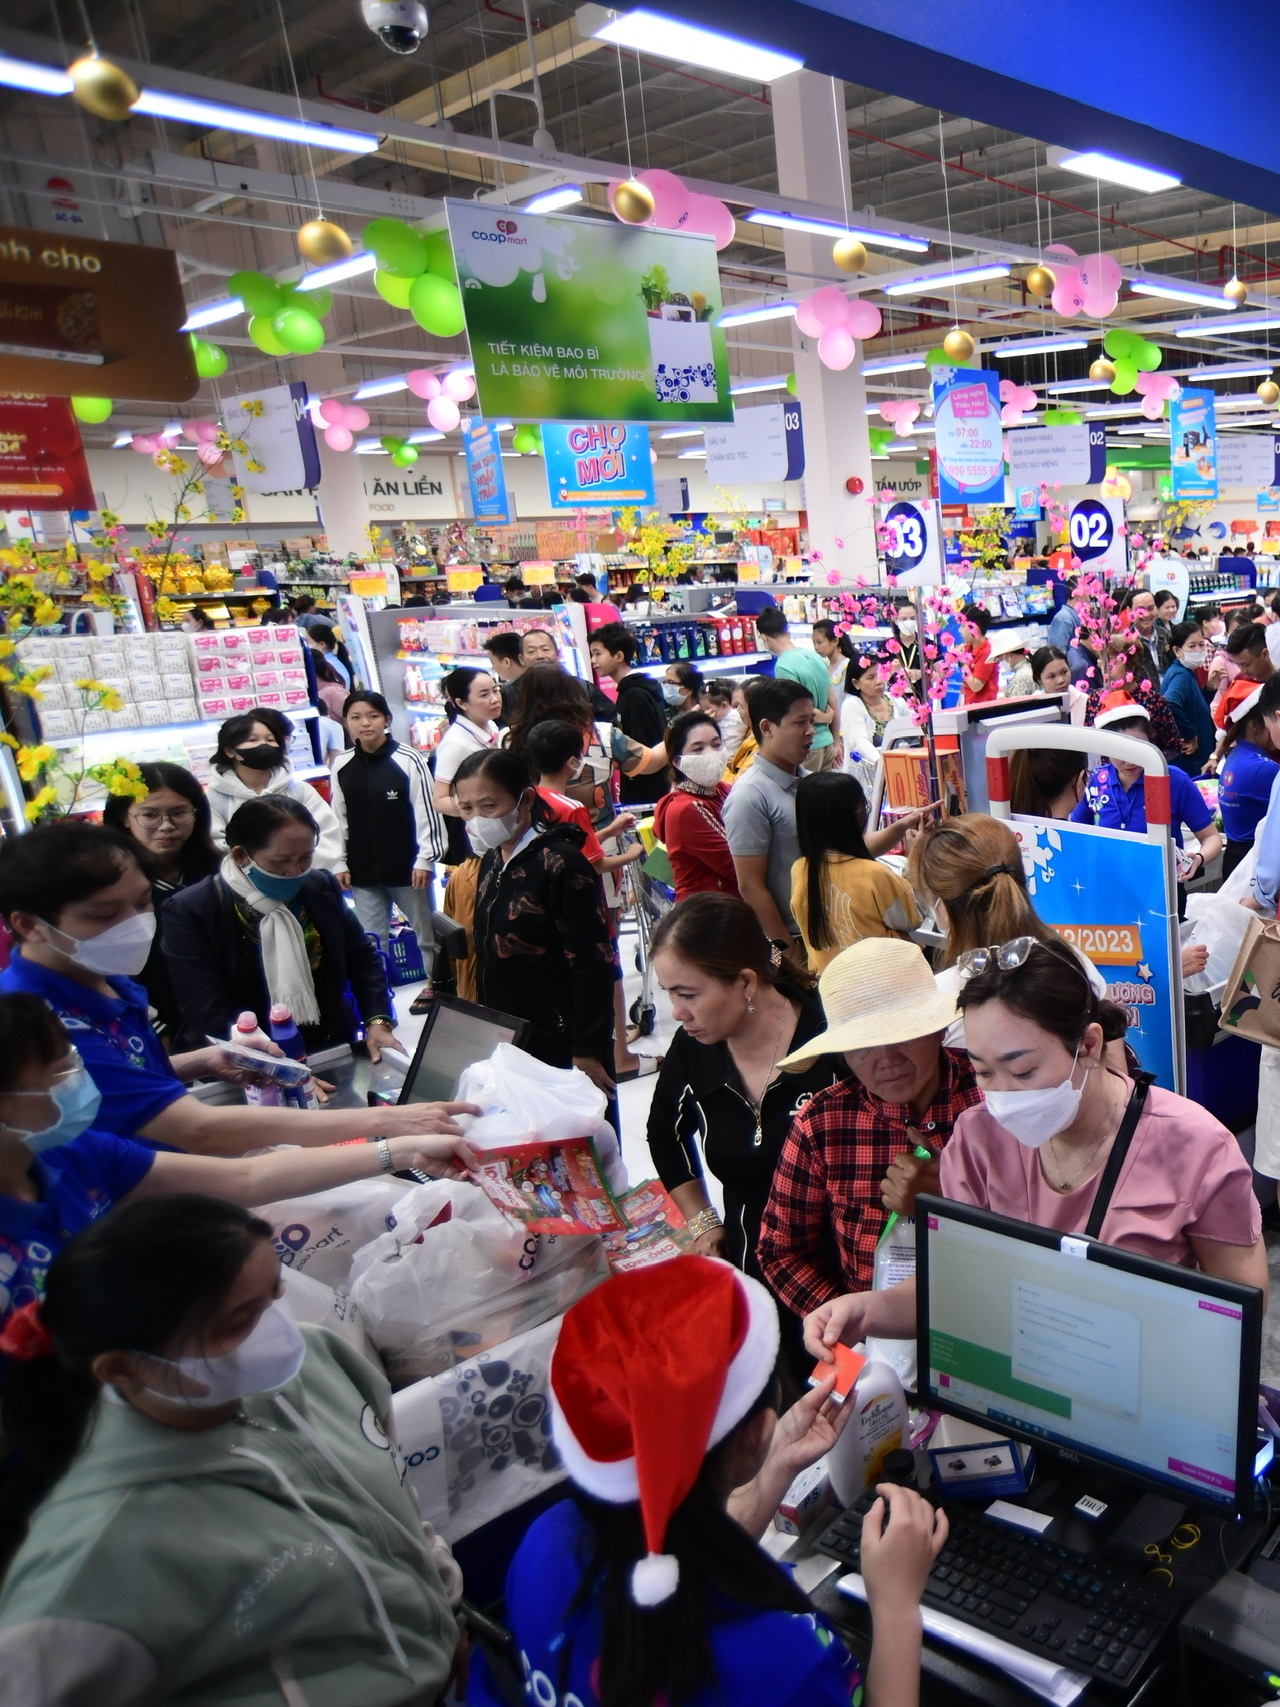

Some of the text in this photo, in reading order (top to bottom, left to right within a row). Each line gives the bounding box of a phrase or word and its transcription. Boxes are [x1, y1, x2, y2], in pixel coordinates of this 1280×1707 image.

[41, 247, 102, 274] cho
[488, 340, 600, 360] TIẾT KIỆM BAO BÌ
[491, 360, 644, 382] LÀ BẢO VỆ MÔI TRƯỜNG
[294, 398, 308, 421] 04
[785, 412, 800, 431] 03
[956, 428, 978, 437] 07:00
[568, 424, 626, 454] CHỢ
[970, 439, 992, 449] 22:00
[1090, 431, 1104, 445] 02
[577, 450, 625, 486] MỚI
[967, 466, 988, 476] 5555
[373, 475, 442, 496] ĂN LIỀN
[887, 517, 924, 558] 03
[1071, 512, 1108, 549] 02
[1056, 928, 1133, 953] 2/2023
[1109, 982, 1155, 1004] ƯƠNG
